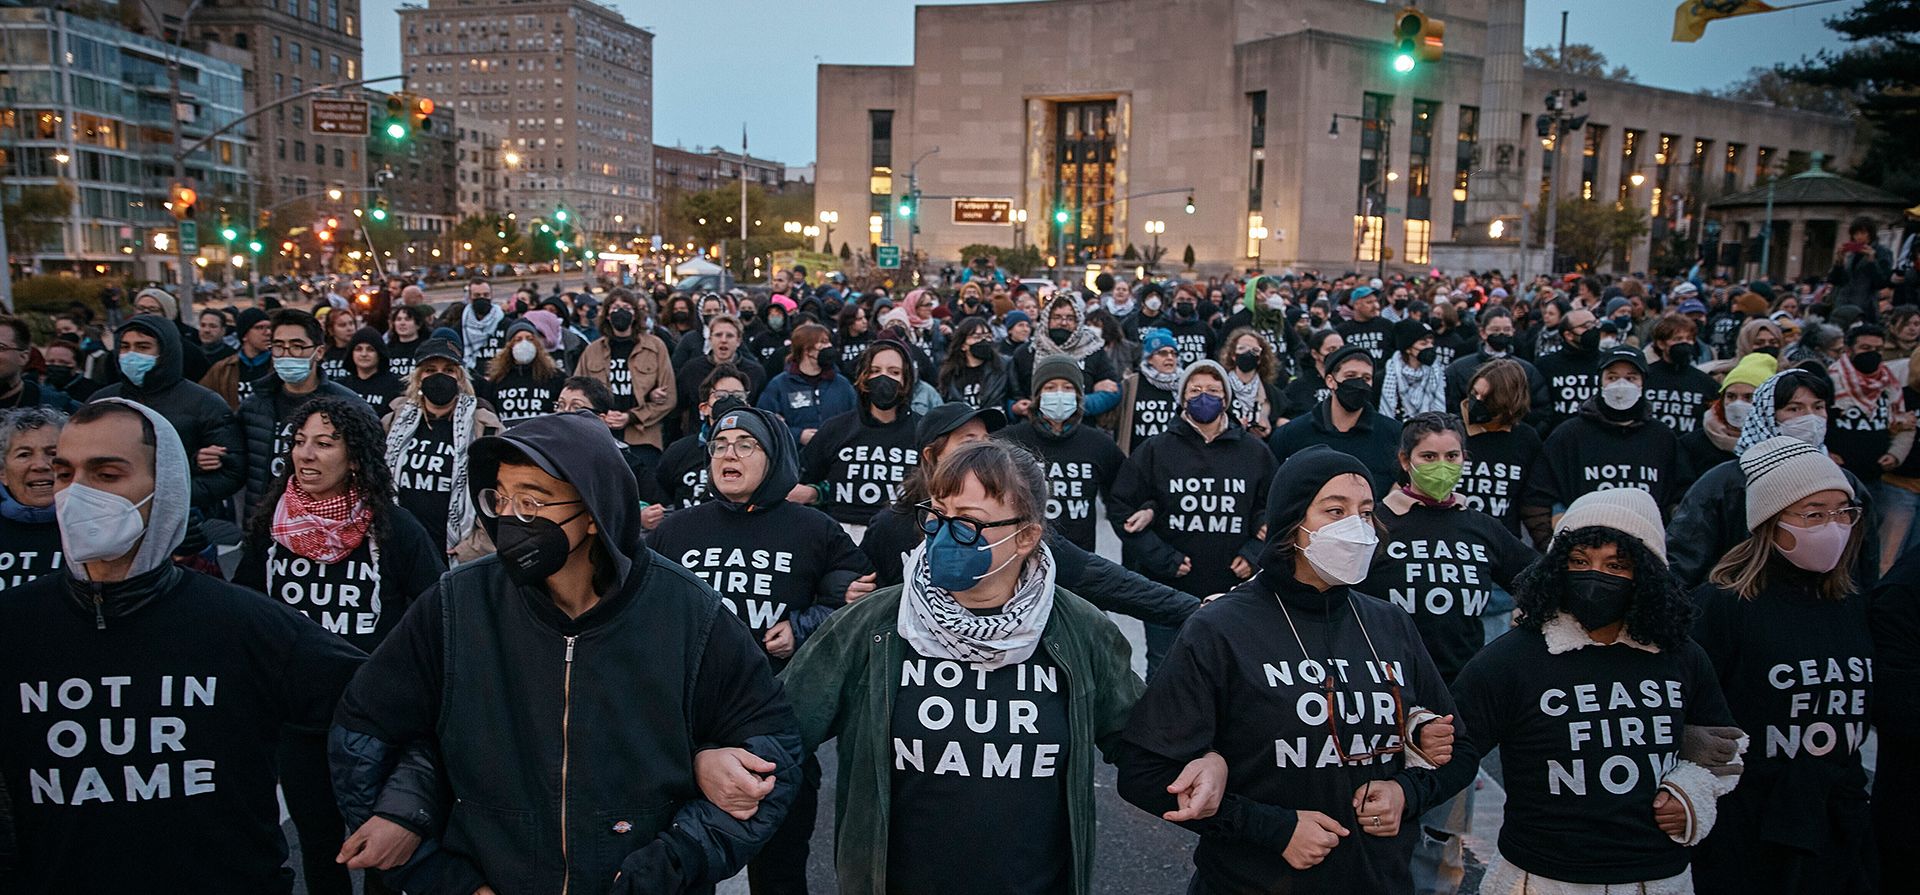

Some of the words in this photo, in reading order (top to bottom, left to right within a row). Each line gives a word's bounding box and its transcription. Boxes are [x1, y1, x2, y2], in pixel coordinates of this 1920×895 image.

[1346, 332, 1384, 344] CEASE
[609, 358, 626, 369] OT
[1552, 374, 1589, 387] NOT
[497, 387, 528, 399] NOT
[533, 388, 550, 399] IN
[1645, 389, 1704, 405] CEASE
[502, 398, 542, 411] OUR
[1135, 400, 1167, 411] NOT
[1652, 401, 1694, 416] FIRE
[1652, 414, 1697, 433] OW
[406, 437, 432, 453] OT
[838, 445, 919, 465] CEASE
[846, 464, 905, 482] FIRE
[1461, 460, 1522, 480] EASE
[1584, 464, 1632, 481] NOT
[1640, 465, 1659, 483] IN
[400, 471, 453, 492] AME
[1169, 478, 1216, 493] NOT
[1224, 478, 1246, 493] IN
[1044, 499, 1090, 520] OW
[1180, 495, 1237, 513] OUR
[1464, 495, 1512, 517] OW
[1169, 514, 1243, 534] NAME
[0, 551, 38, 570] OT
[681, 547, 793, 573] CEASE
[1386, 539, 1489, 563] CEASE
[1405, 562, 1481, 585] FIRE
[281, 581, 360, 608] OUR
[1388, 586, 1490, 617] NOW
[300, 610, 376, 635] ME
[900, 659, 995, 691] NOT
[1016, 663, 1058, 693] IN
[1262, 658, 1350, 688] NOT
[19, 676, 131, 713] NOT
[160, 675, 217, 707] IN
[1539, 679, 1684, 717] CEASE
[917, 695, 1040, 734] OUR
[1295, 691, 1396, 726] OUR
[46, 716, 188, 758] OUR
[1568, 715, 1674, 752] FIRE
[893, 737, 1061, 779] NAME
[29, 759, 217, 806] NAME
